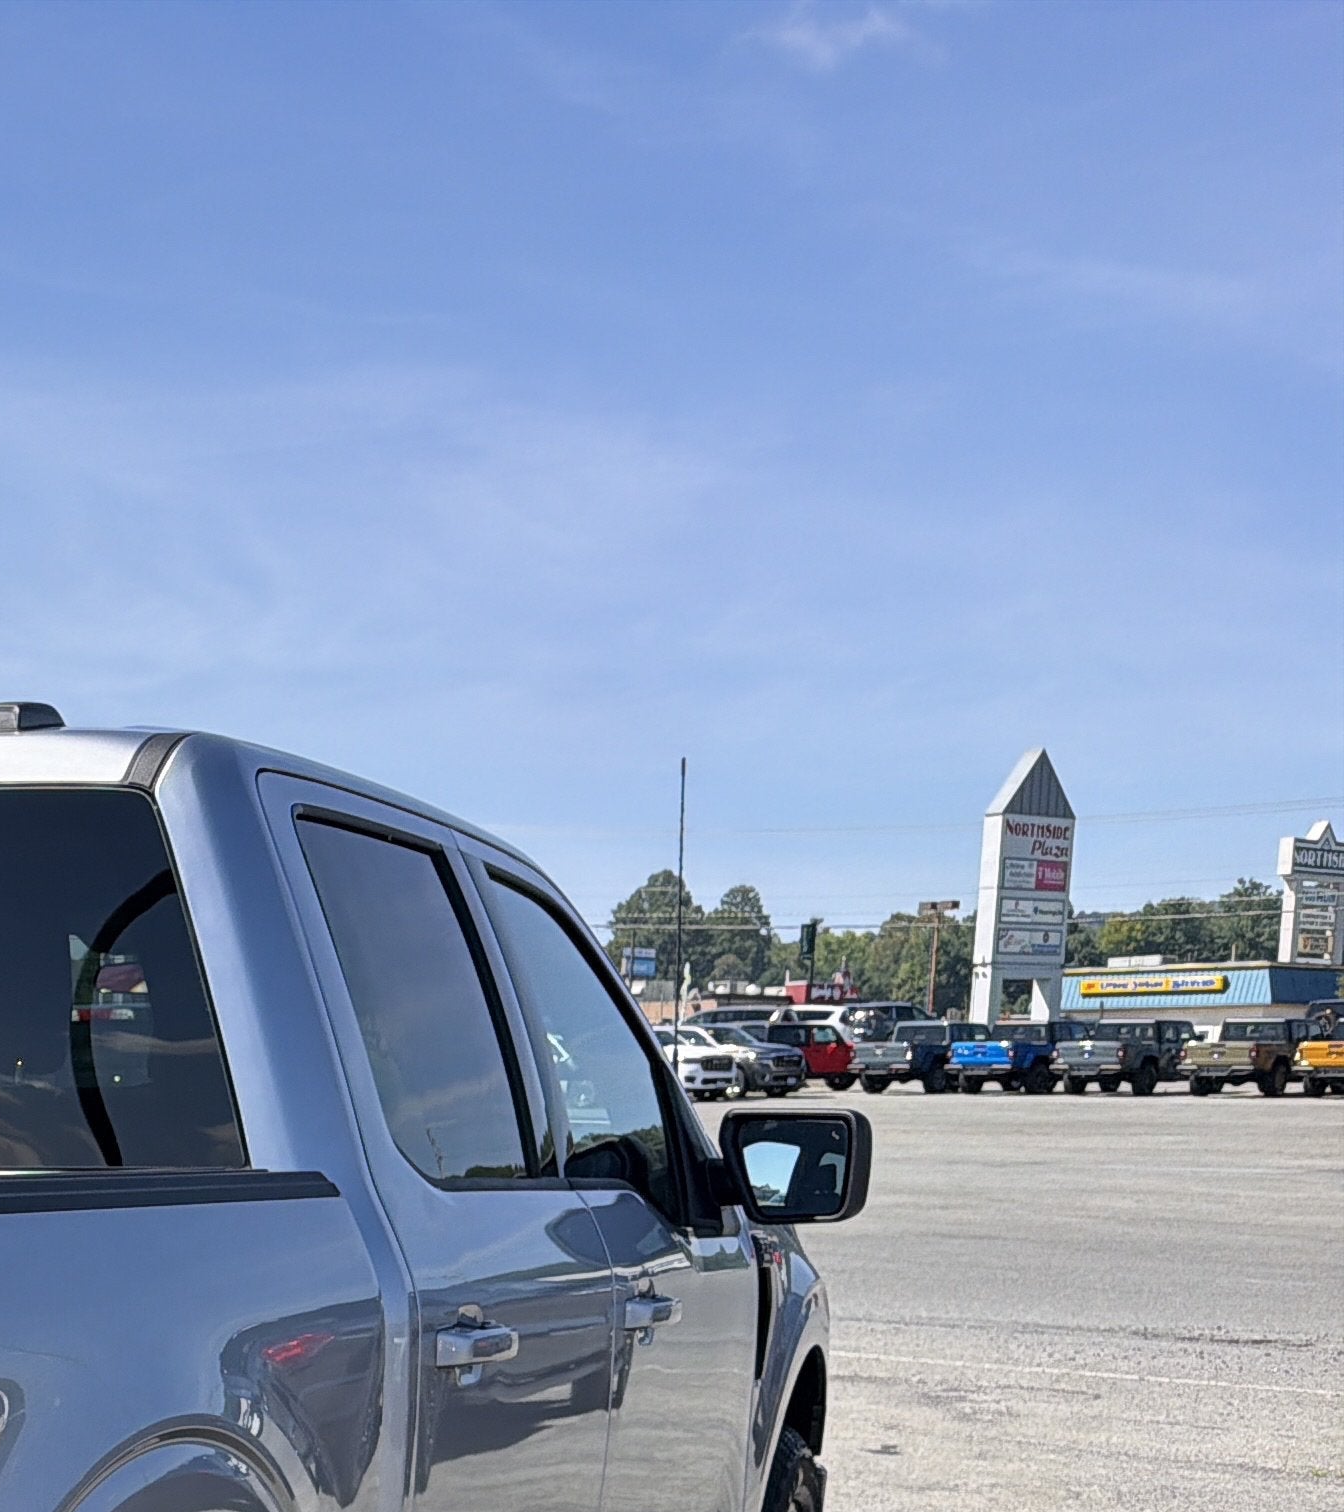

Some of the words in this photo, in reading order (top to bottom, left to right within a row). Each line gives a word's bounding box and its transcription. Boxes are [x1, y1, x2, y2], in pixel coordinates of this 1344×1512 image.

[1006, 819, 1070, 840] NORTHSIDE
[1031, 840, 1069, 858] Plaza
[1294, 849, 1344, 869] NORTHSI
